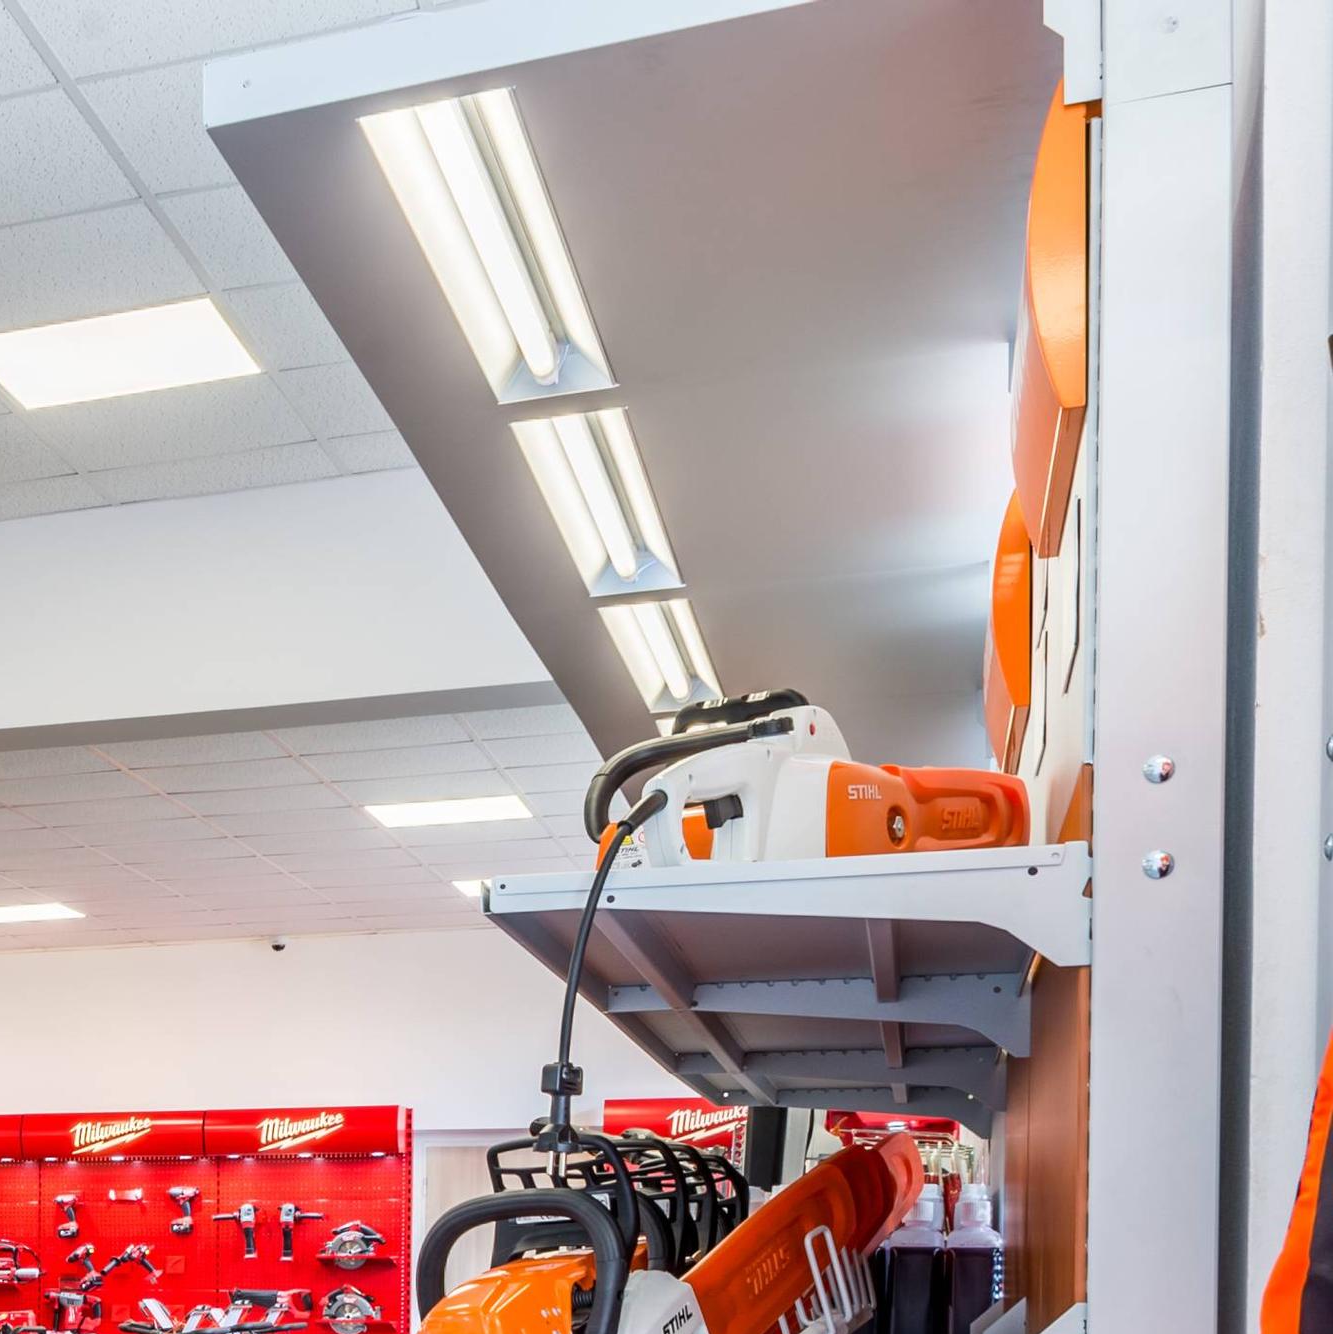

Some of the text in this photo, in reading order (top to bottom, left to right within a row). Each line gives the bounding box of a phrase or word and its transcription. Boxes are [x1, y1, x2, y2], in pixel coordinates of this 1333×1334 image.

[848, 784, 882, 799] STIHL
[941, 806, 981, 830] STIHL
[70, 1117, 151, 1147] Milwaukee
[257, 1112, 344, 1144] Milwaukee
[666, 1105, 749, 1136] Milwauke
